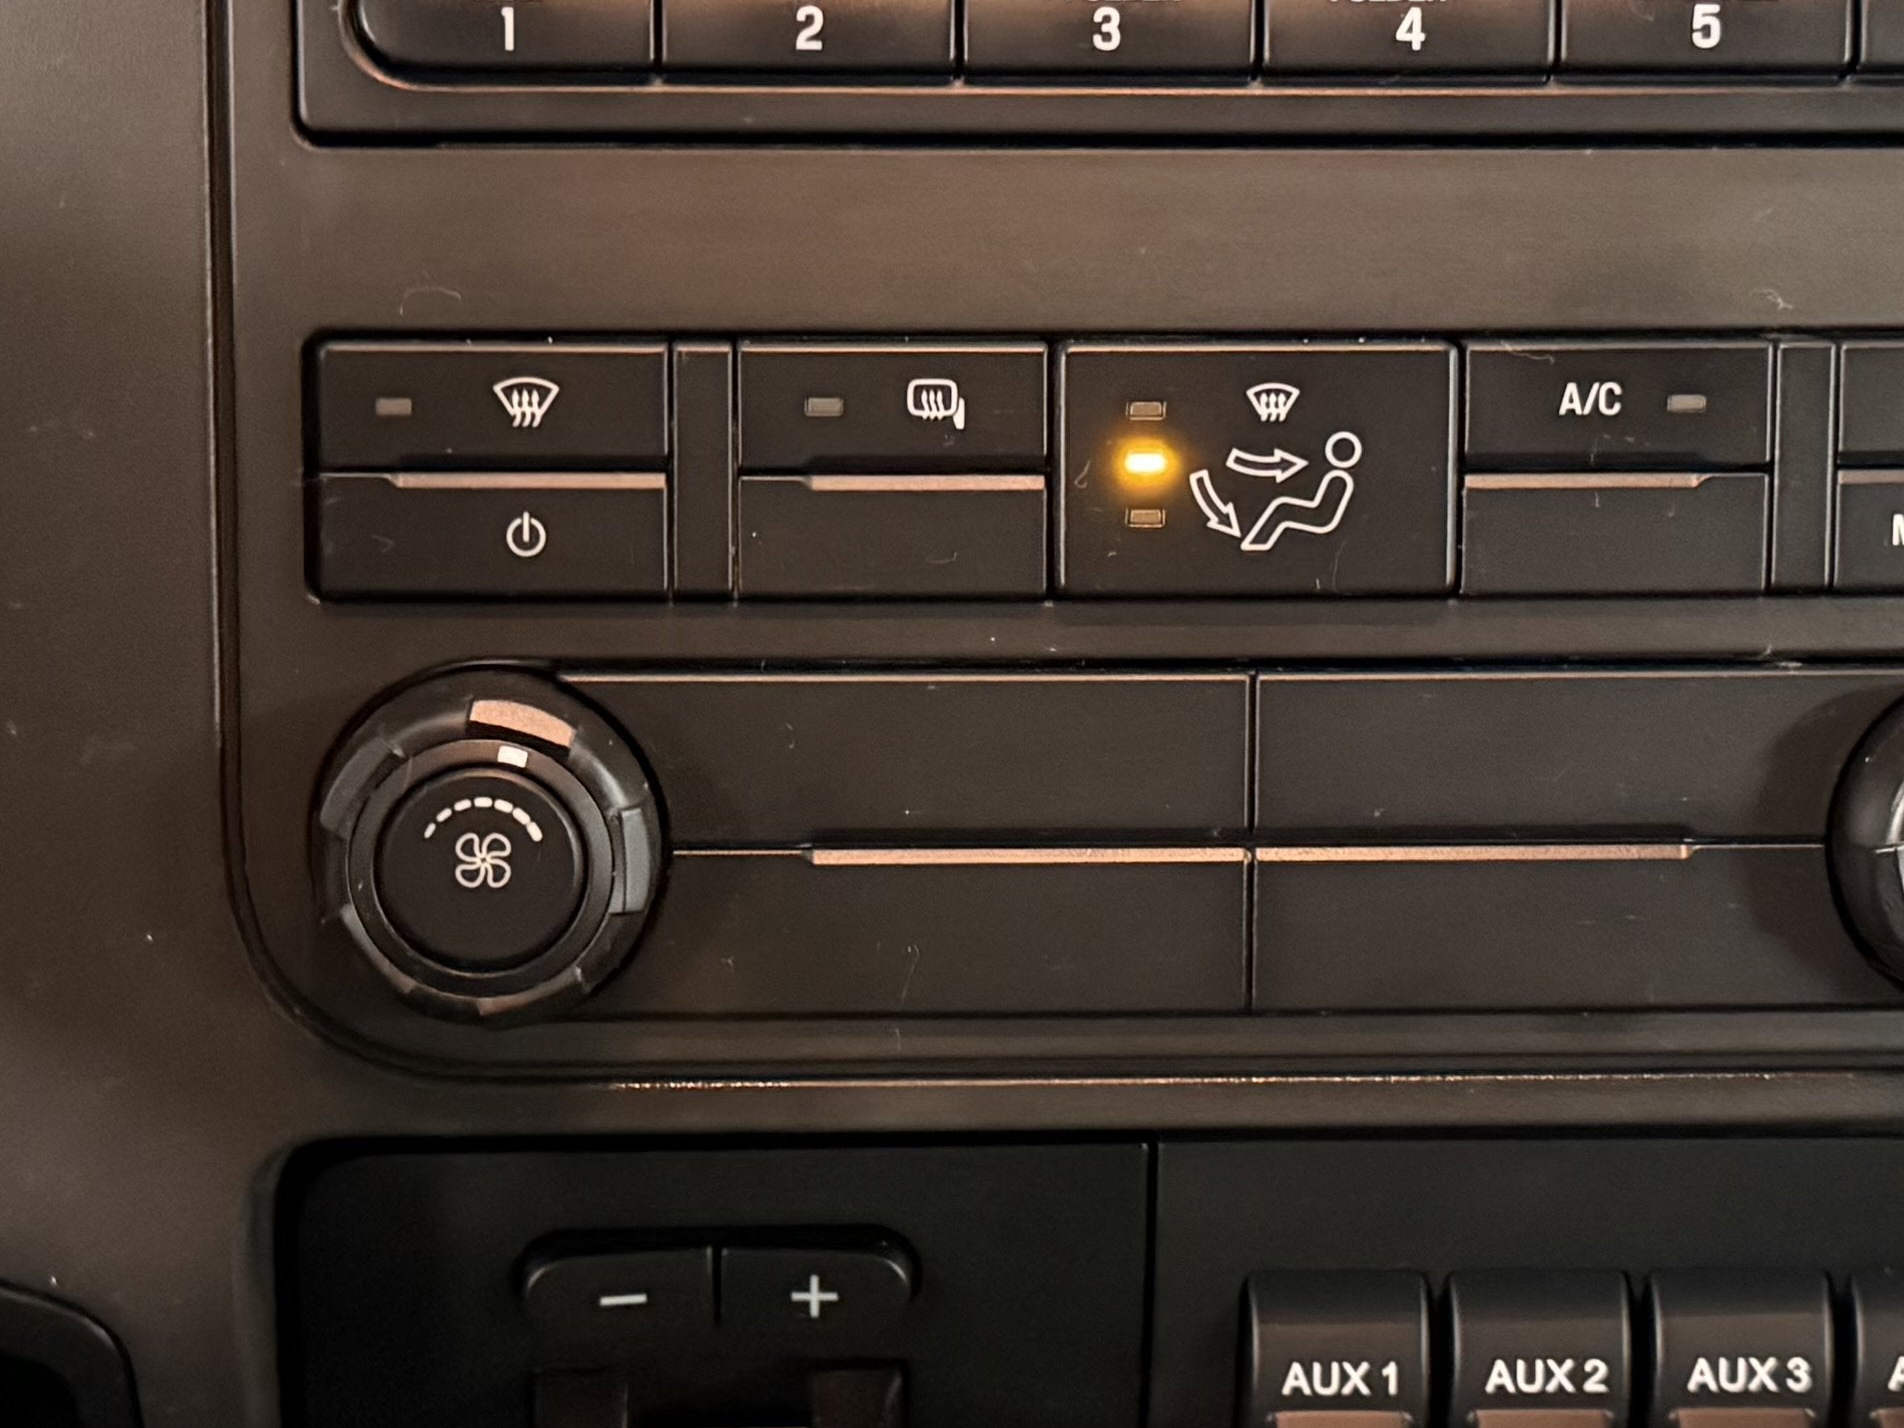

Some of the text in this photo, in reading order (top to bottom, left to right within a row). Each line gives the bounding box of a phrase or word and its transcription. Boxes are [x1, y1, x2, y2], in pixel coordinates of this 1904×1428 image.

[499, 4, 517, 53] 1
[793, 3, 825, 53] 2
[1091, 4, 1122, 53] 3
[1394, 6, 1428, 52] 4
[1690, 5, 1723, 50] 5
[1557, 380, 1624, 419] A/C
[1280, 1360, 1399, 1397] AUX 1
[1484, 1357, 1609, 1395] AUX 2
[1686, 1355, 1813, 1394] AUX 3
